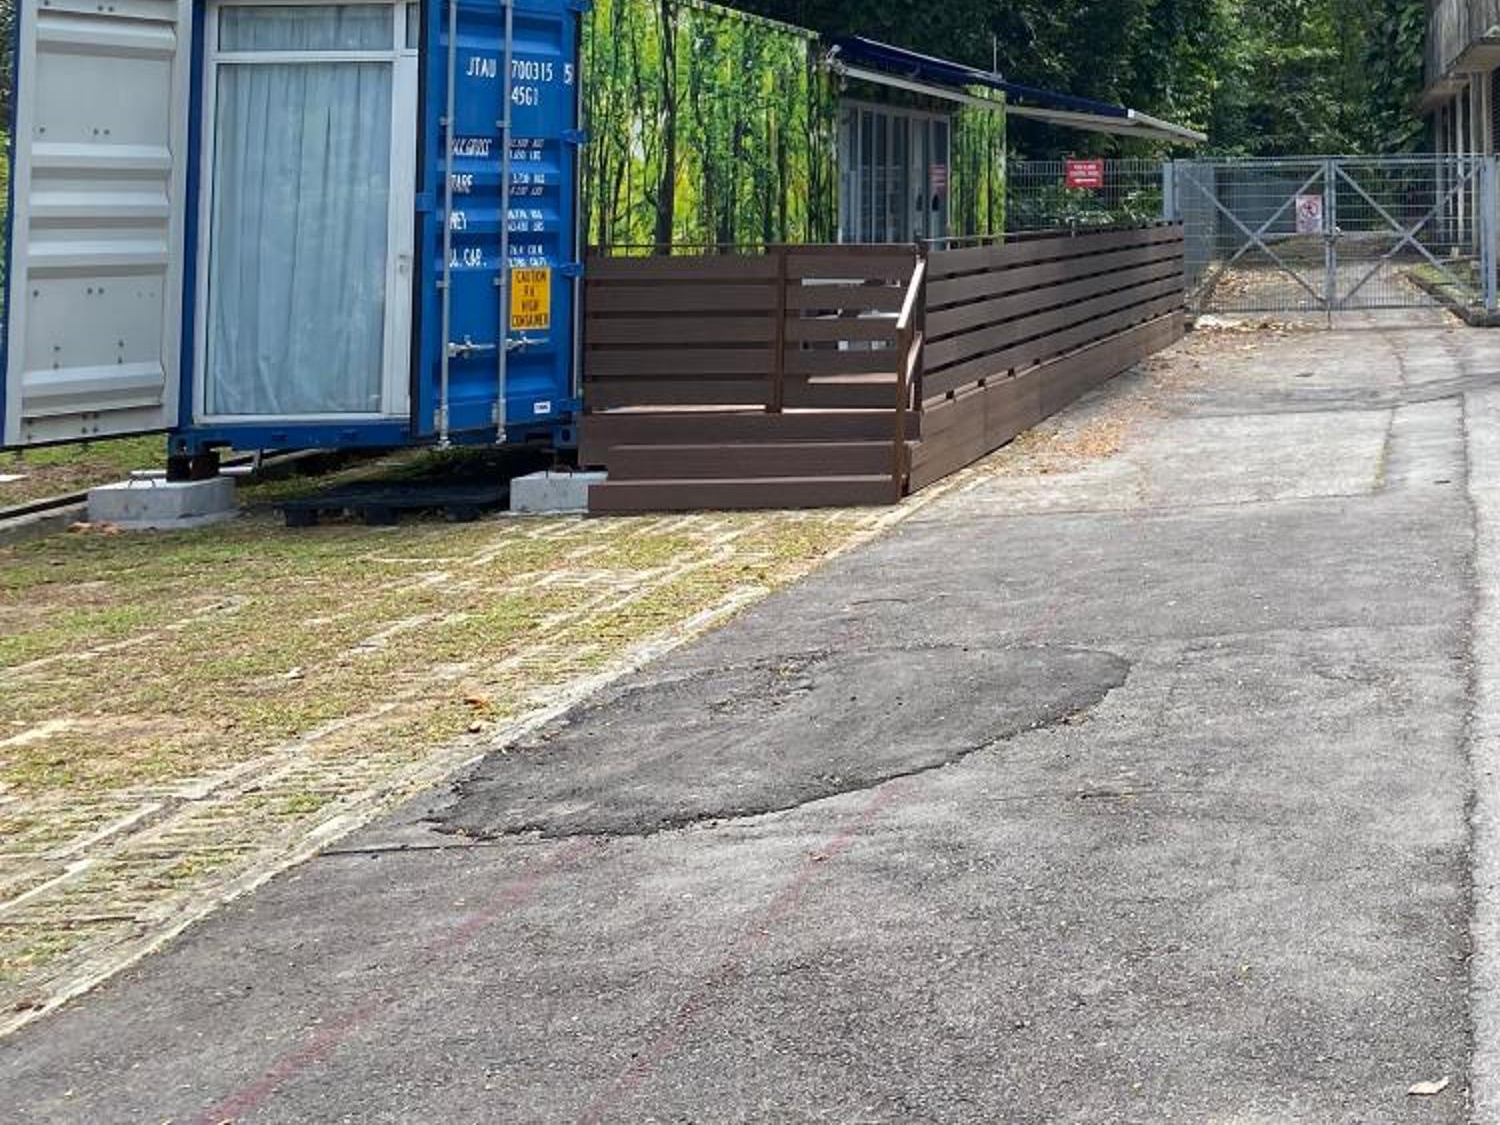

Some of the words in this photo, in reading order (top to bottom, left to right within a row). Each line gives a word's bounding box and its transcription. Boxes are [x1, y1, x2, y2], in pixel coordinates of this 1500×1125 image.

[466, 57, 497, 78] JTAU
[511, 60, 553, 82] 700315
[564, 62, 574, 85] 5
